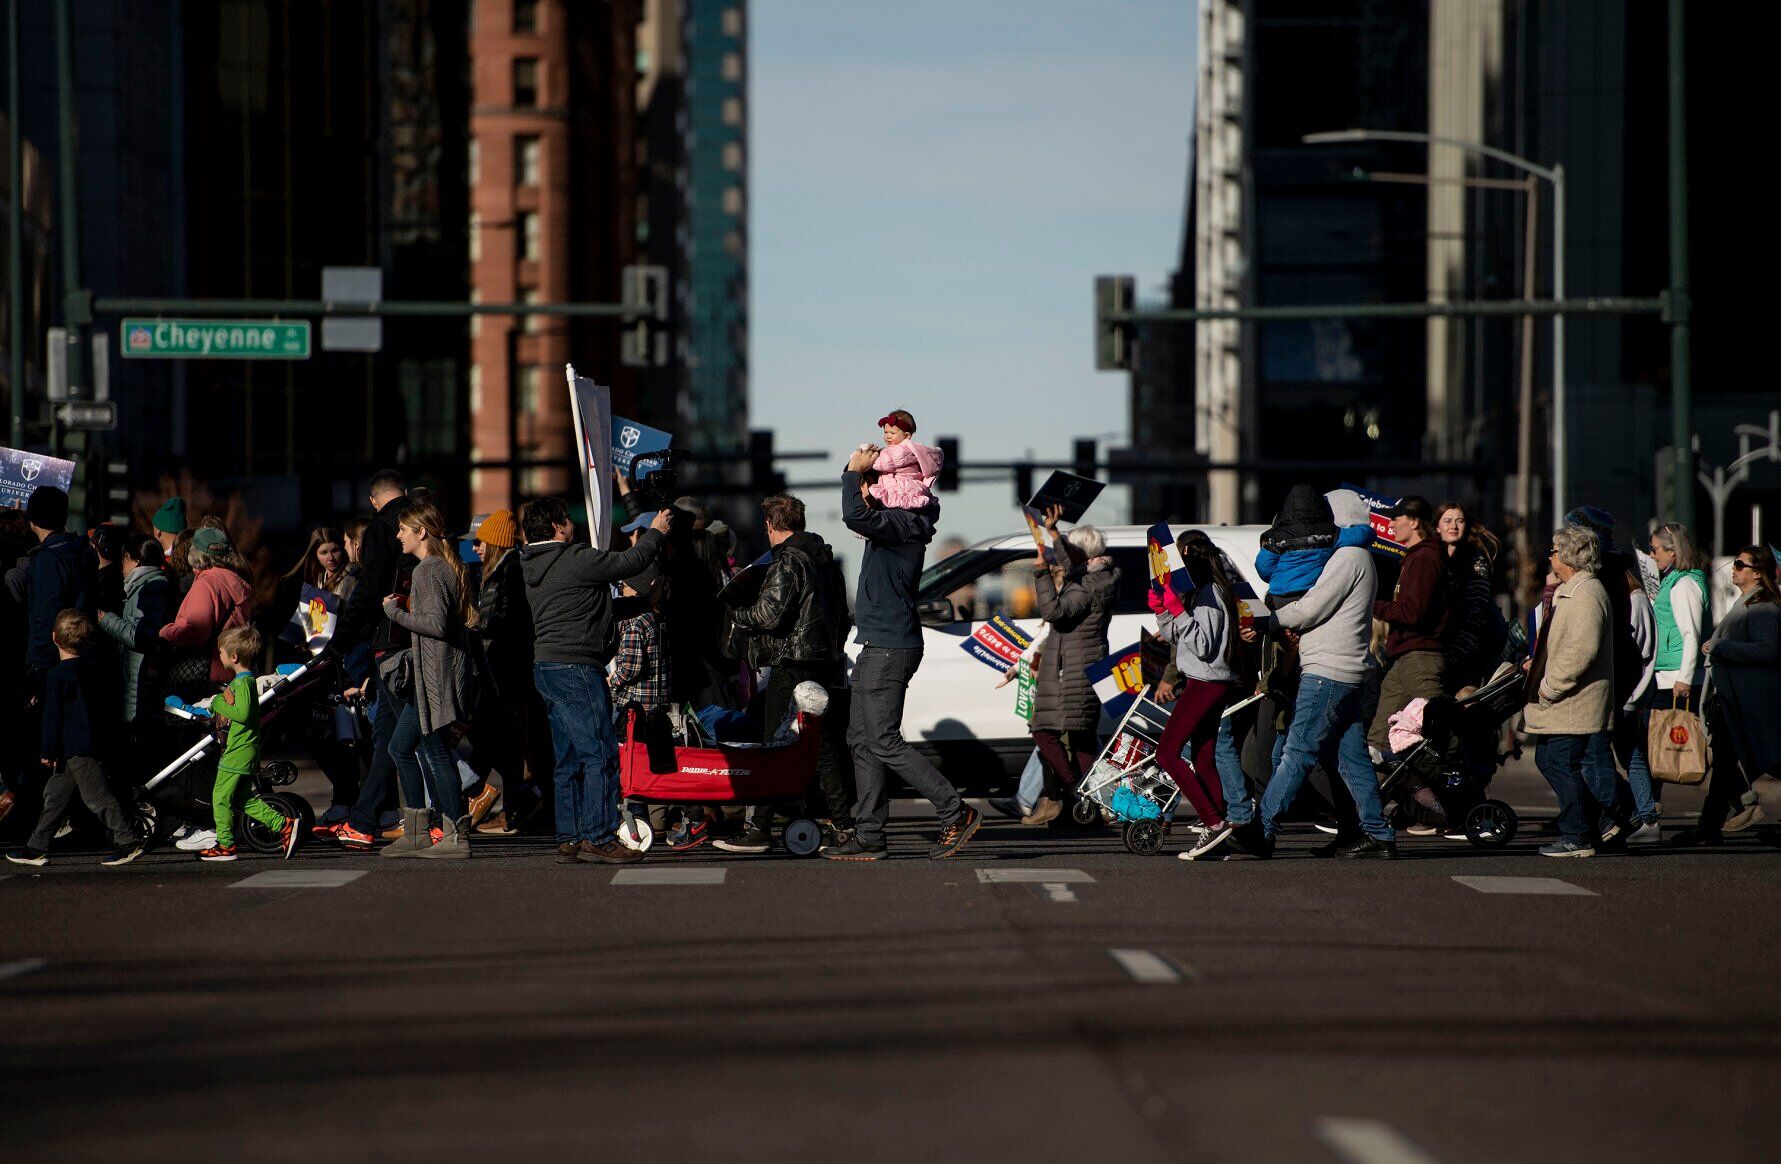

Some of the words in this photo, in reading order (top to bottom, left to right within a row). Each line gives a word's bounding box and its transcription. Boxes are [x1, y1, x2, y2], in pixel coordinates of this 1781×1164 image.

[155, 323, 275, 355] Cheyenne
[1, 487, 29, 497] UNIVER
[1377, 523, 1386, 533] to
[978, 627, 1003, 648] 84576
[1001, 644, 1011, 654] to
[1020, 659, 1031, 687] LIFE
[1017, 685, 1029, 716] LOVE
